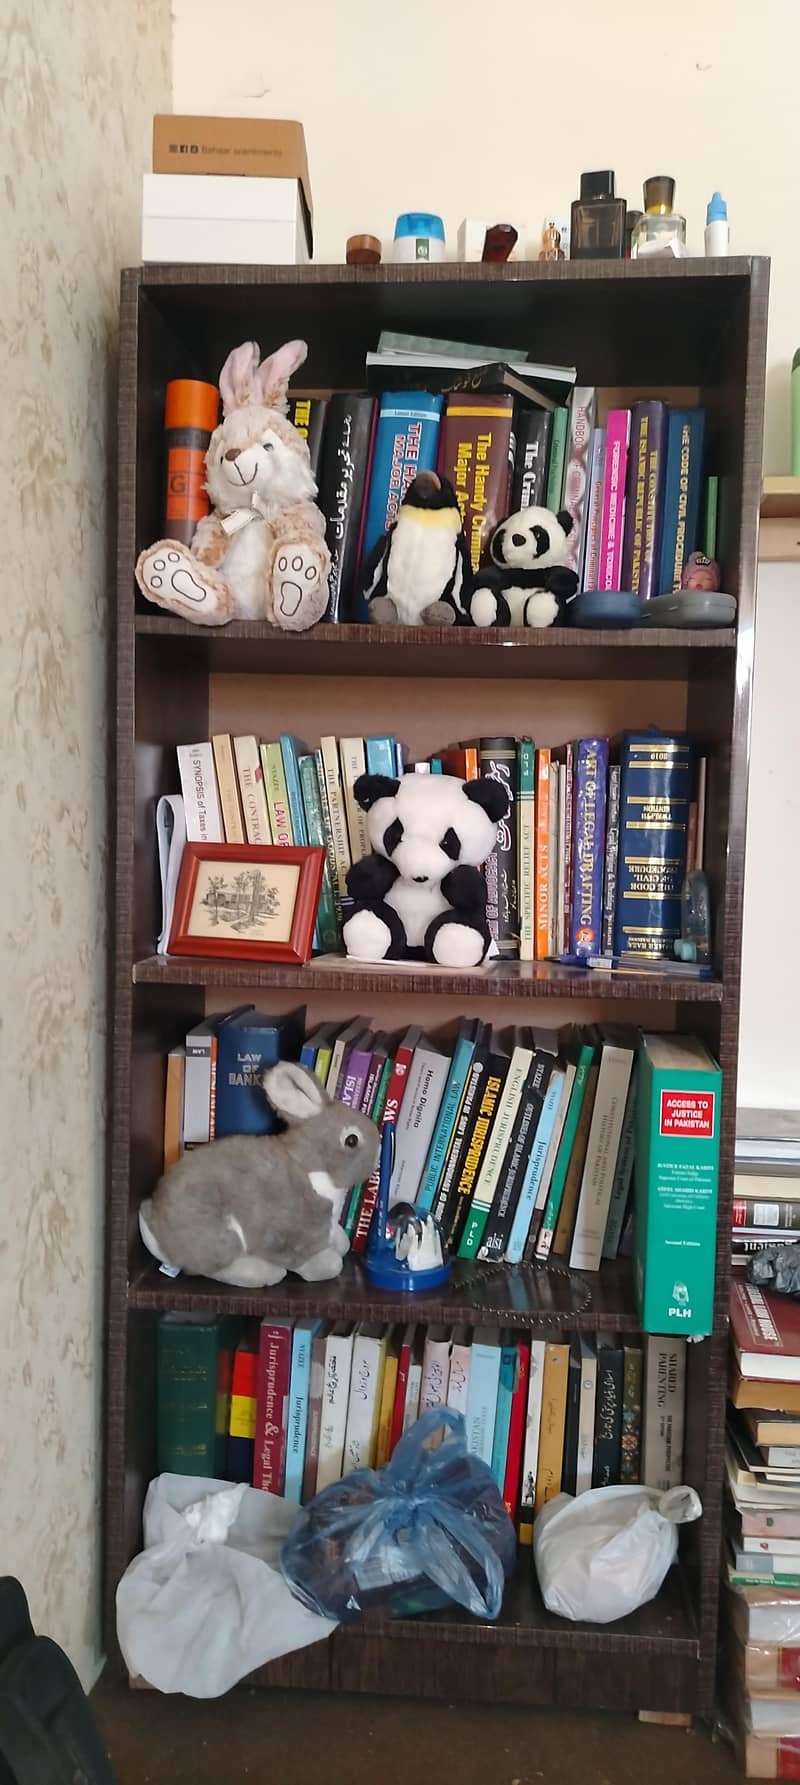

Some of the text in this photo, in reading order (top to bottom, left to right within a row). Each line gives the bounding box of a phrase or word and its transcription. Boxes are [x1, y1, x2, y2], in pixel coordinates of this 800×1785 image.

[406, 422, 423, 460] THE
[640, 416, 649, 437] THE
[476, 432, 491, 461] The
[524, 441, 539, 469] The
[637, 438, 647, 481] ISLAMIC
[648, 450, 658, 471] THE
[680, 446, 690, 475] CODE
[454, 442, 472, 486] Major
[610, 440, 621, 491] FORENSIC
[384, 434, 406, 532] MAJOR ACTS
[470, 464, 490, 511] Handy
[679, 477, 689, 492] OF
[330, 481, 348, 540] مقدمات
[607, 492, 618, 540] MEDICINE
[635, 482, 646, 532] REPUBLIC
[645, 473, 657, 547] CONSTITUTION
[678, 493, 688, 520] CIVIL
[633, 533, 643, 548] OF
[673, 521, 686, 582] PROCEDURE
[242, 767, 253, 790] THE
[351, 756, 359, 770] THE
[357, 814, 364, 825] OF
[192, 759, 208, 841] SYNOPSIS of Taxes in
[273, 801, 287, 828] LAW
[327, 768, 347, 878] THE PARTNERSHIP ACT
[580, 750, 597, 925] ART OF LEGAL DRAFTING
[525, 847, 533, 876] RELIEF
[539, 844, 550, 871] ACTS
[628, 864, 679, 874] PROCEDURE
[630, 882, 656, 891] CODE
[633, 873, 660, 882] CIVIL
[485, 904, 499, 919] OF
[525, 882, 533, 921] SPECIFIC
[538, 881, 549, 930] MINOR
[525, 926, 533, 941] THE
[237, 1053, 262, 1062] LAW
[242, 1064, 259, 1073] OF
[228, 1072, 264, 1087] BANK
[421, 1069, 433, 1095] Homo
[412, 1096, 426, 1128] Dignita
[518, 1102, 534, 1134] OUTLINES
[666, 1099, 709, 1109] ACCESS TO
[671, 1109, 703, 1119] JUSTICE
[423, 1080, 461, 1192] PUBLIC INTERNATIONAL LAW
[458, 1075, 500, 1196] ISLAMIC JURISPRUDENCE
[482, 1067, 522, 1187] ENGLISH JURISPRUDENCE
[516, 1133, 526, 1144] OF
[664, 1118, 710, 1129] IN PAKISTAN
[439, 1192, 447, 1201] OF
[457, 1115, 468, 1135] LAWS
[509, 1143, 523, 1169] ISLAMIC
[524, 1139, 546, 1201] Jurisprudence
[355, 1206, 373, 1239] THE
[668, 1307, 692, 1319] PLH
[657, 1352, 666, 1407] PARENTING
[668, 1353, 677, 1392] SHARED
[262, 1342, 280, 1468] Jurisprudence & Legal
[598, 1368, 617, 1440] اسلامی بنیاد پرستی کی تاریخ
[291, 1396, 303, 1453] Jurisprudence
[467, 1415, 482, 1454] AKISTAN
